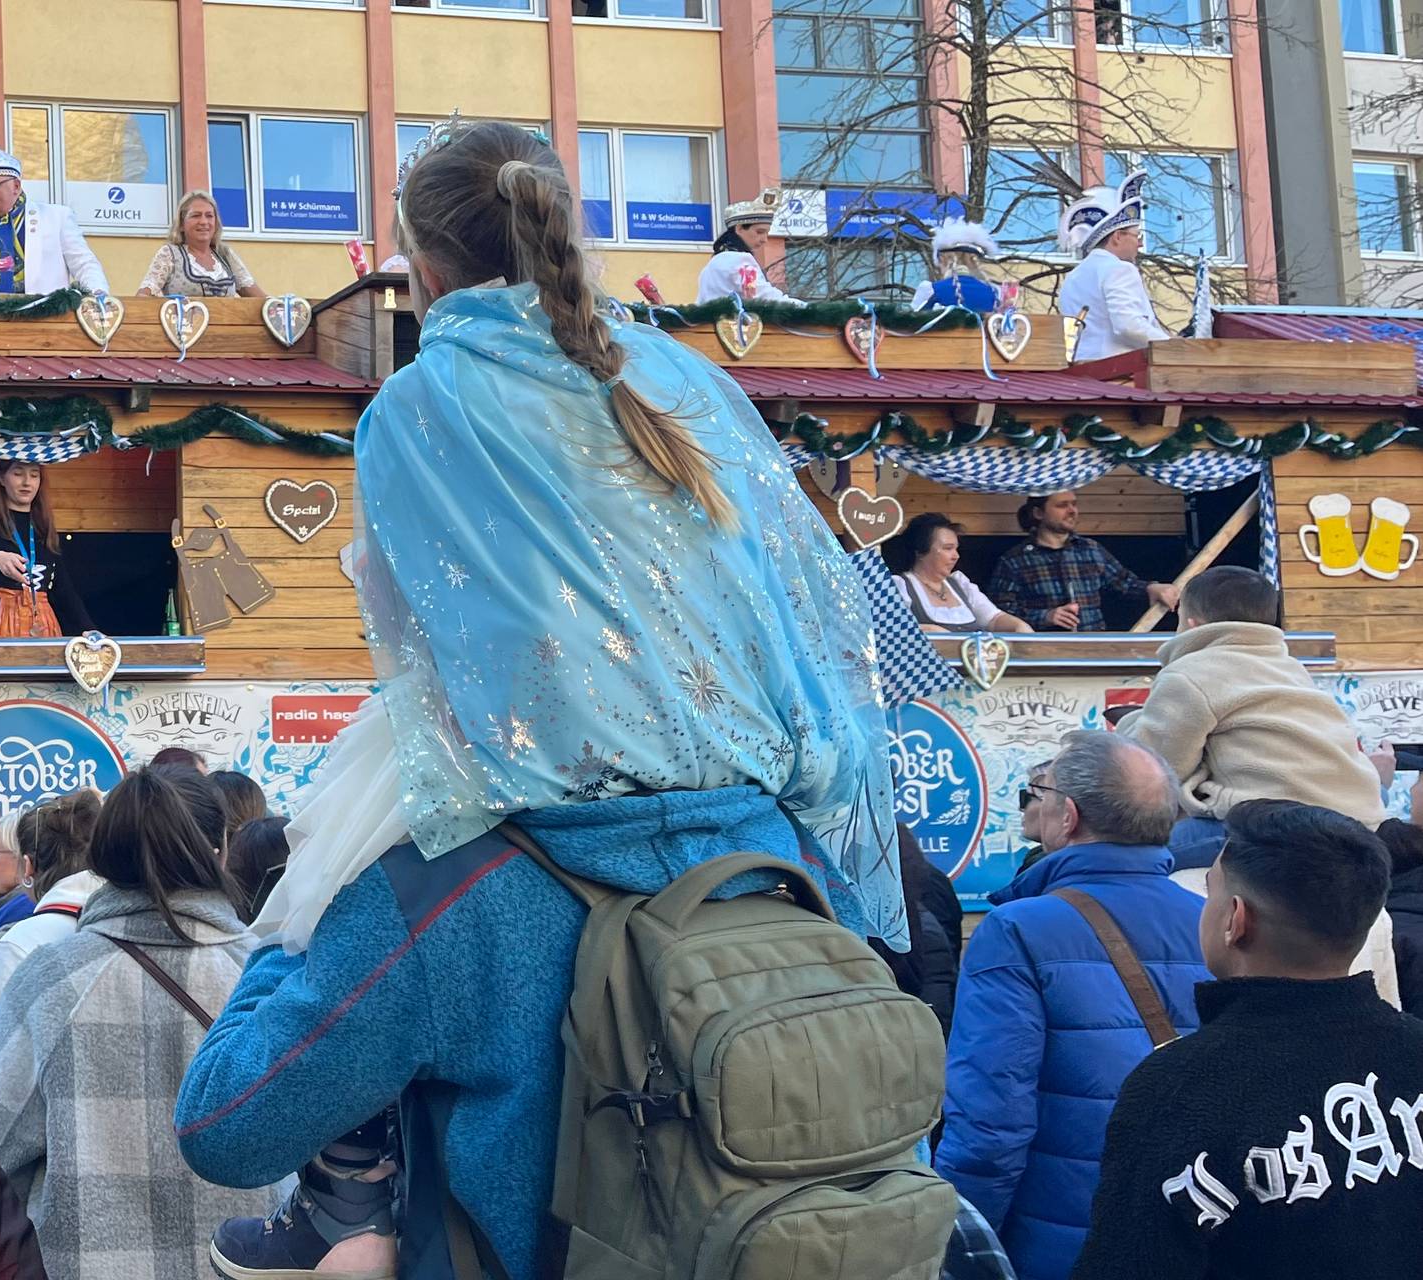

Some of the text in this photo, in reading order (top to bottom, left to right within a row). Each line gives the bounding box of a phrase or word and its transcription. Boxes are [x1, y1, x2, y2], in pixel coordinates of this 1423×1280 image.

[298, 202, 341, 211] Schürmann
[94, 209, 141, 220] ZURICH
[778, 218, 817, 228] ZURICH
[129, 692, 242, 724] DREISAM
[1006, 702, 1054, 719] LIVE
[1379, 696, 1421, 712] LIVE
[159, 709, 213, 728] LIVE
[276, 708, 353, 722] radio hag
